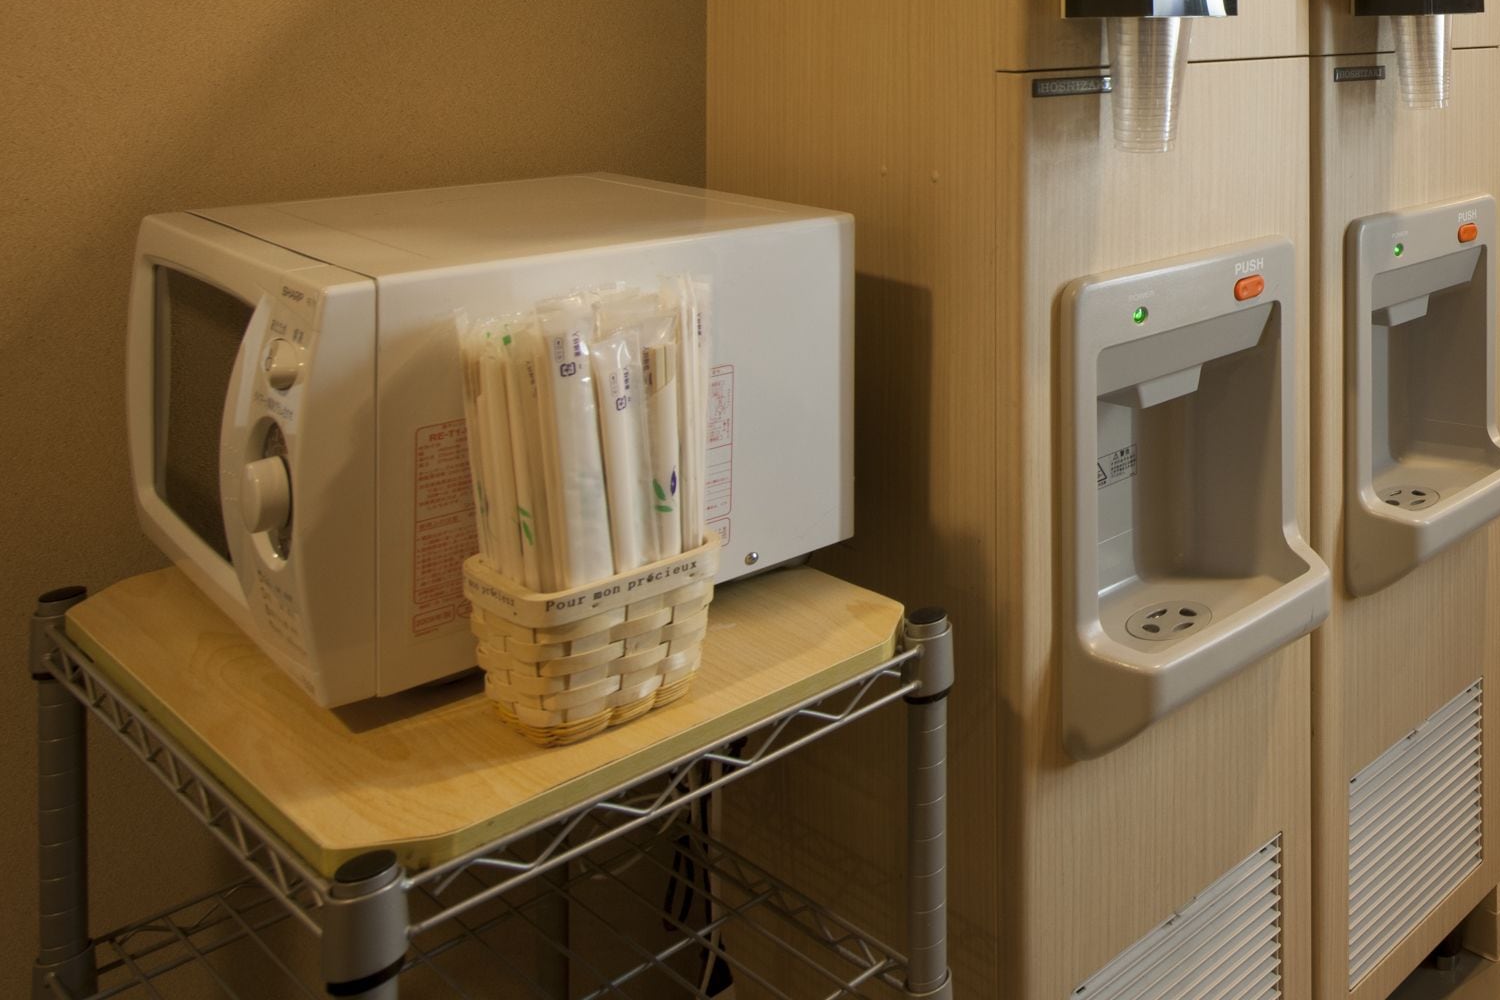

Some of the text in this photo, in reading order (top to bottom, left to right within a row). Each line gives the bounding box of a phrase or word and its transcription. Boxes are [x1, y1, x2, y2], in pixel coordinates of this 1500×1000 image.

[1458, 208, 1477, 222] PUSH
[1235, 257, 1264, 276] PUSH
[281, 285, 305, 302] SHARP
[545, 560, 698, 612] Pour mon précieux
